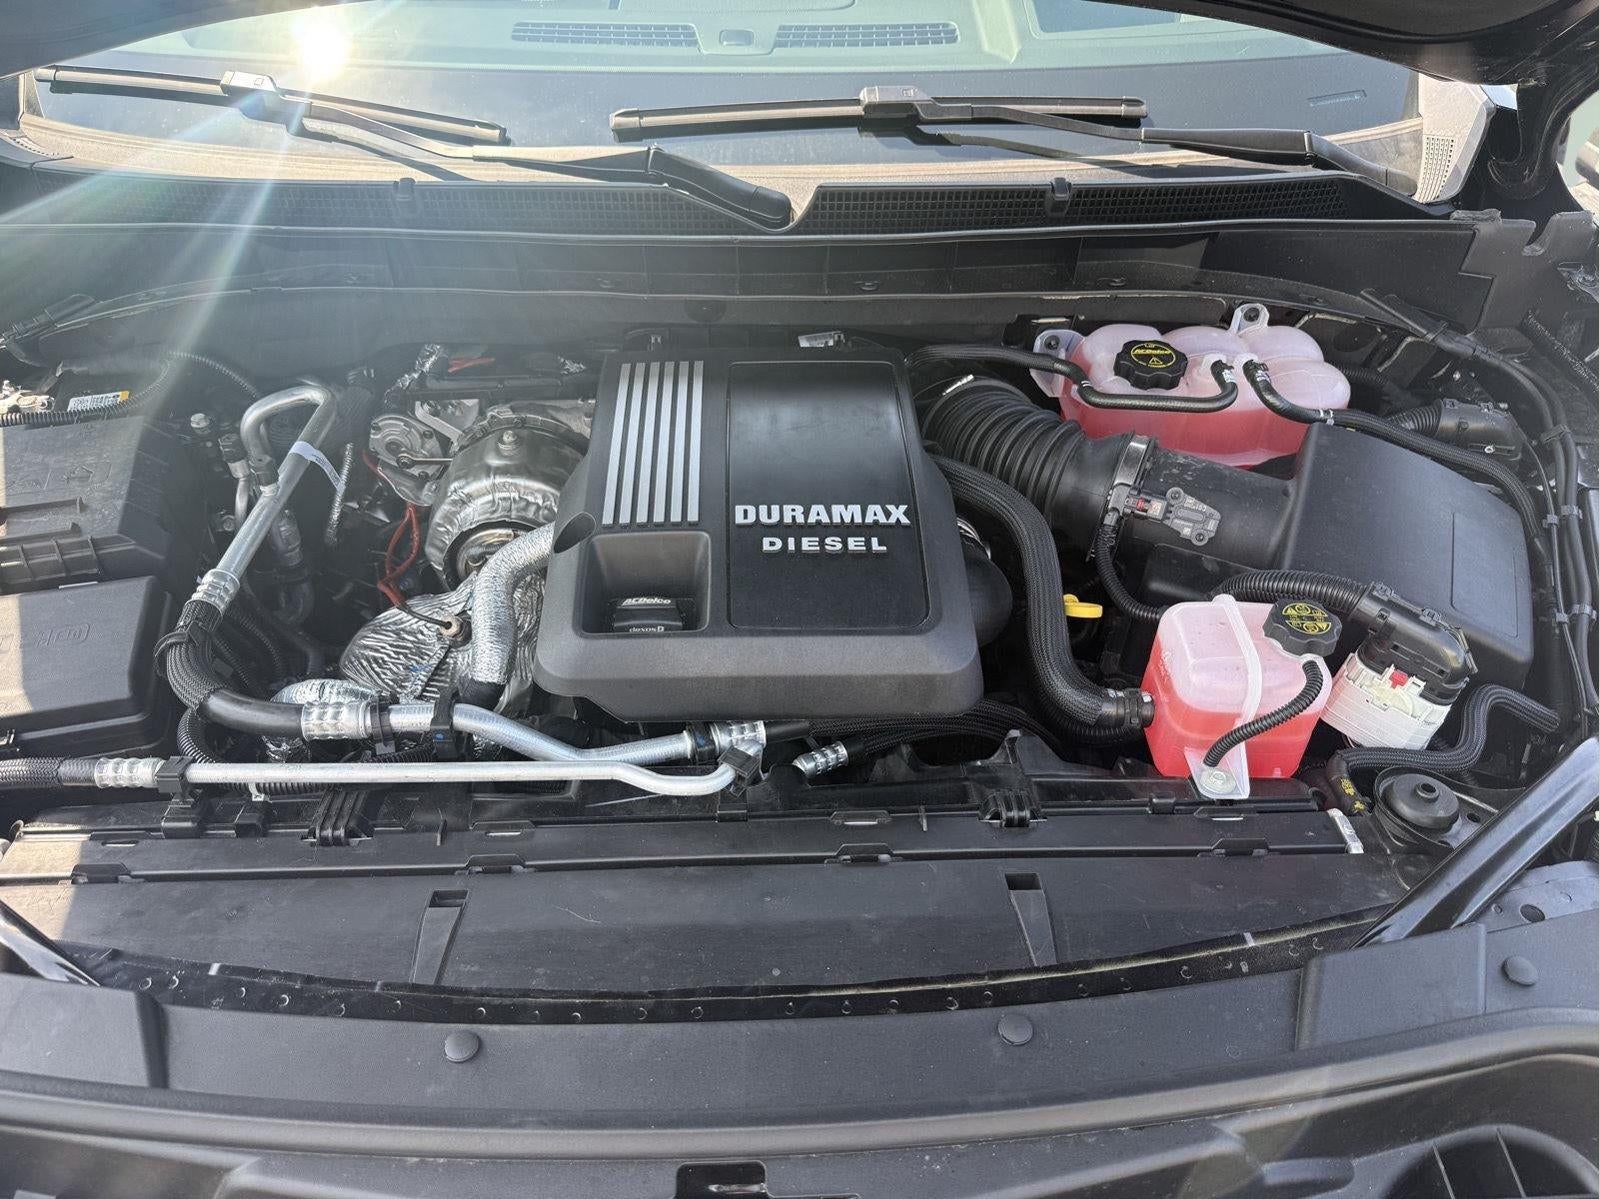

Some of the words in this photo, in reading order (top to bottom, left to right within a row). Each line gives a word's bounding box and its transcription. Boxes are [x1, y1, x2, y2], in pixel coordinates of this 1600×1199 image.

[735, 504, 911, 526] DURAMAX
[762, 537, 887, 553] DIESEL
[621, 597, 671, 606] ACDelco
